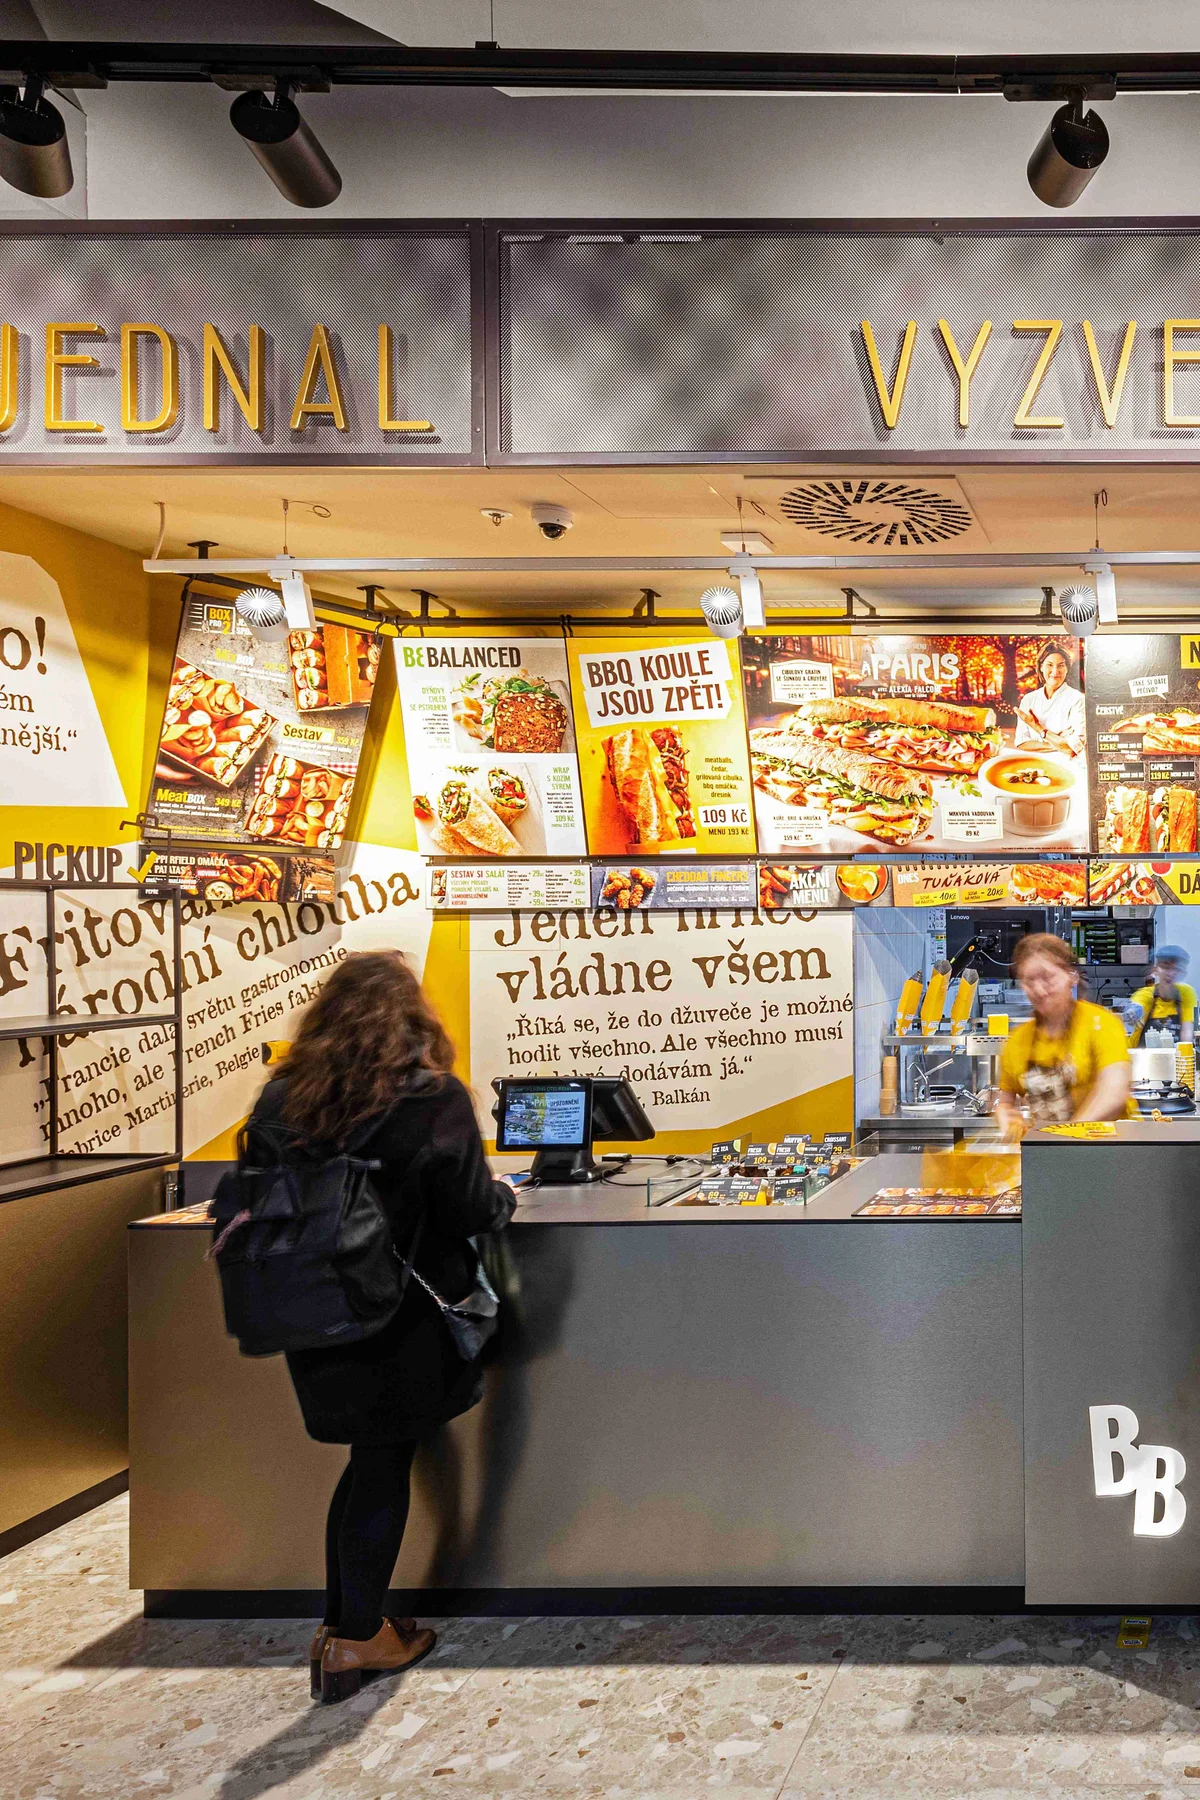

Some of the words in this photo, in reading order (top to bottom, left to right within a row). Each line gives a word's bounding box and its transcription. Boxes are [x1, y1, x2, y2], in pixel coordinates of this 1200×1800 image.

[209, 608, 231, 621] BOX
[222, 620, 231, 634] 2
[426, 646, 522, 668] BALANCED
[586, 658, 636, 688] BBQ
[643, 650, 713, 680] KOULE
[870, 653, 960, 684] PARIS
[889, 685, 912, 693] ALEXIA
[597, 687, 655, 718] JSOU
[662, 682, 724, 713] ZPĚT!
[283, 725, 323, 741] Sestav
[696, 774, 722, 783] grilovaná
[1151, 772, 1161, 780] 119
[156, 789, 206, 805] MeatBOX
[215, 798, 230, 807] 349
[703, 809, 727, 823] 109
[732, 809, 748, 823] Kč
[14, 842, 123, 883] PICKUP
[197, 855, 229, 867] OMÁČKA
[450, 870, 475, 879] SESTAV
[477, 870, 483, 878] SI
[485, 868, 505, 878] SALÁT
[710, 870, 749, 882] FINGERS
[789, 869, 830, 890] AKČNÍ
[897, 872, 919, 884] DNES
[793, 887, 829, 905] MENU
[236, 872, 420, 962] chlouba
[496, 951, 672, 1004] vládne
[692, 938, 832, 988] všem
[187, 995, 236, 1030] světu
[241, 946, 348, 1008] gastronomie
[573, 1017, 600, 1036] se,
[607, 1010, 630, 1032] že
[637, 1009, 663, 1028] do
[670, 1002, 753, 1025] džuveče
[759, 1000, 780, 1022] je
[787, 993, 853, 1017] možné
[134, 1064, 164, 1091] ale
[239, 998, 285, 1034] Fries
[507, 1042, 562, 1065] hodit
[569, 1037, 657, 1060] všechno.
[660, 1032, 698, 1053] Ale
[704, 1028, 787, 1049] všechno
[794, 1021, 844, 1044] musí
[215, 1046, 260, 1080] Belgie
[619, 1060, 712, 1083] dodávám
[652, 1089, 711, 1108] Balkán
[722, 1154, 732, 1163] 59
[833, 1147, 842, 1155] 29
[753, 1156, 767, 1164] 109
[785, 1156, 795, 1164] 69
[814, 1156, 824, 1164] 49
[707, 1191, 719, 1199] 69
[737, 1191, 749, 1200] 69
[786, 1189, 796, 1197] 65
[1089, 1404, 1187, 1538] BB
